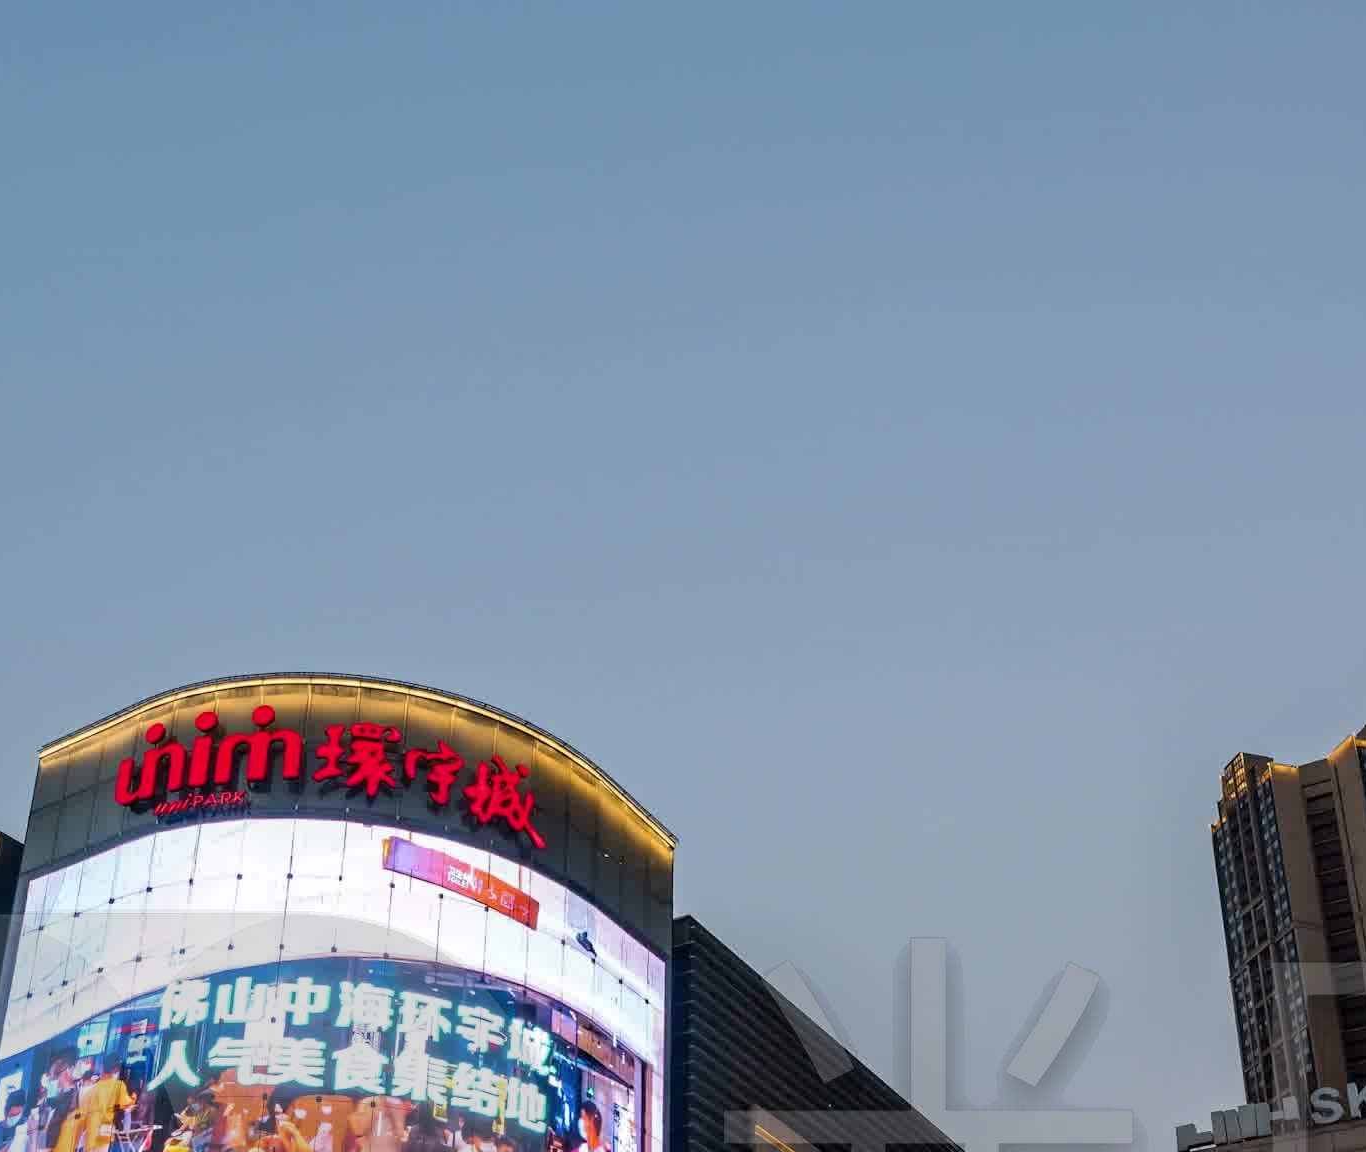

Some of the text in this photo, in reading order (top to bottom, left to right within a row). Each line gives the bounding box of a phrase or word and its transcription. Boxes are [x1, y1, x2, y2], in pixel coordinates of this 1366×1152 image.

[158, 974, 554, 1077] 佛山中海环宇城
[148, 1036, 547, 1134] 人气美食集结地
